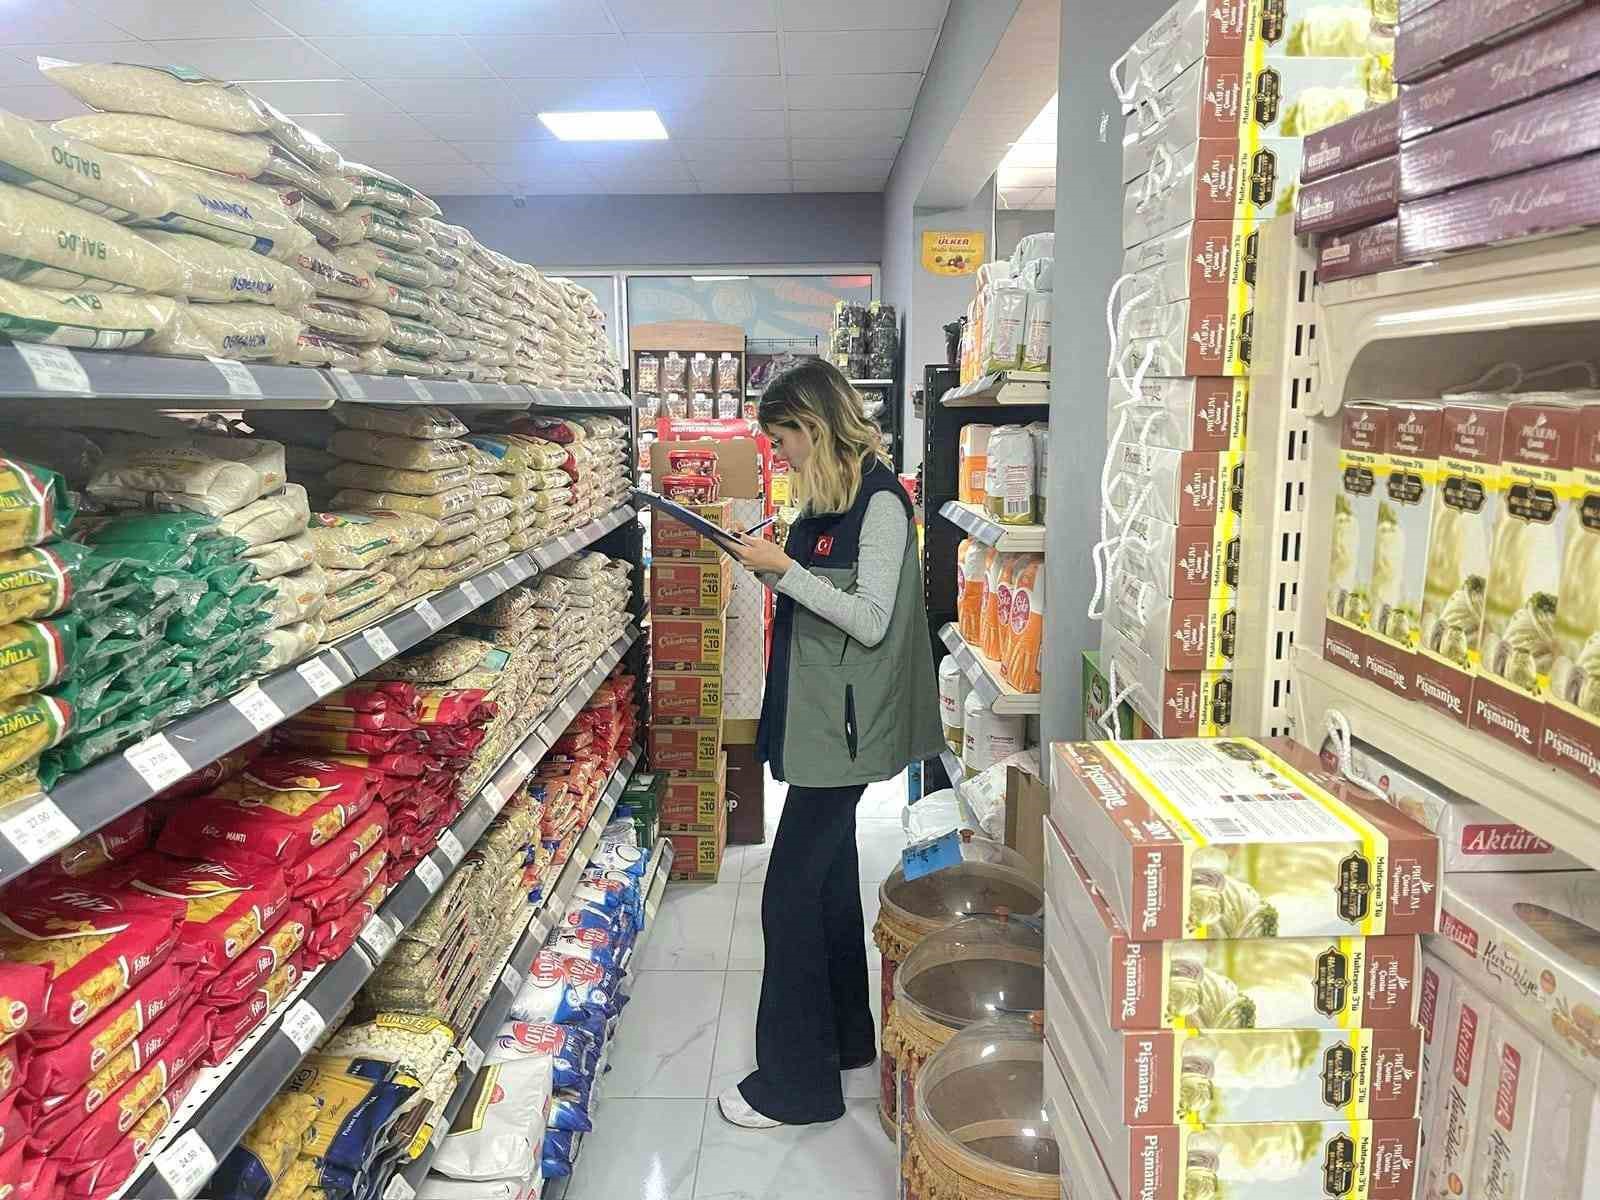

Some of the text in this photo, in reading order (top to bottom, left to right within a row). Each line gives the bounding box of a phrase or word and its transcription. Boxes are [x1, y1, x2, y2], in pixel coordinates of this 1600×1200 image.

[1325, 638, 1361, 668] Pişmaniye
[1365, 655, 1408, 690] Pişmaniye
[1416, 673, 1463, 714] Pişmaniye
[1476, 699, 1533, 745] Pişmaniye
[1142, 851, 1162, 932] Pişmaniye
[1121, 943, 1141, 1021] Pişmaniye
[1134, 1041, 1153, 1118] Pişmaniye
